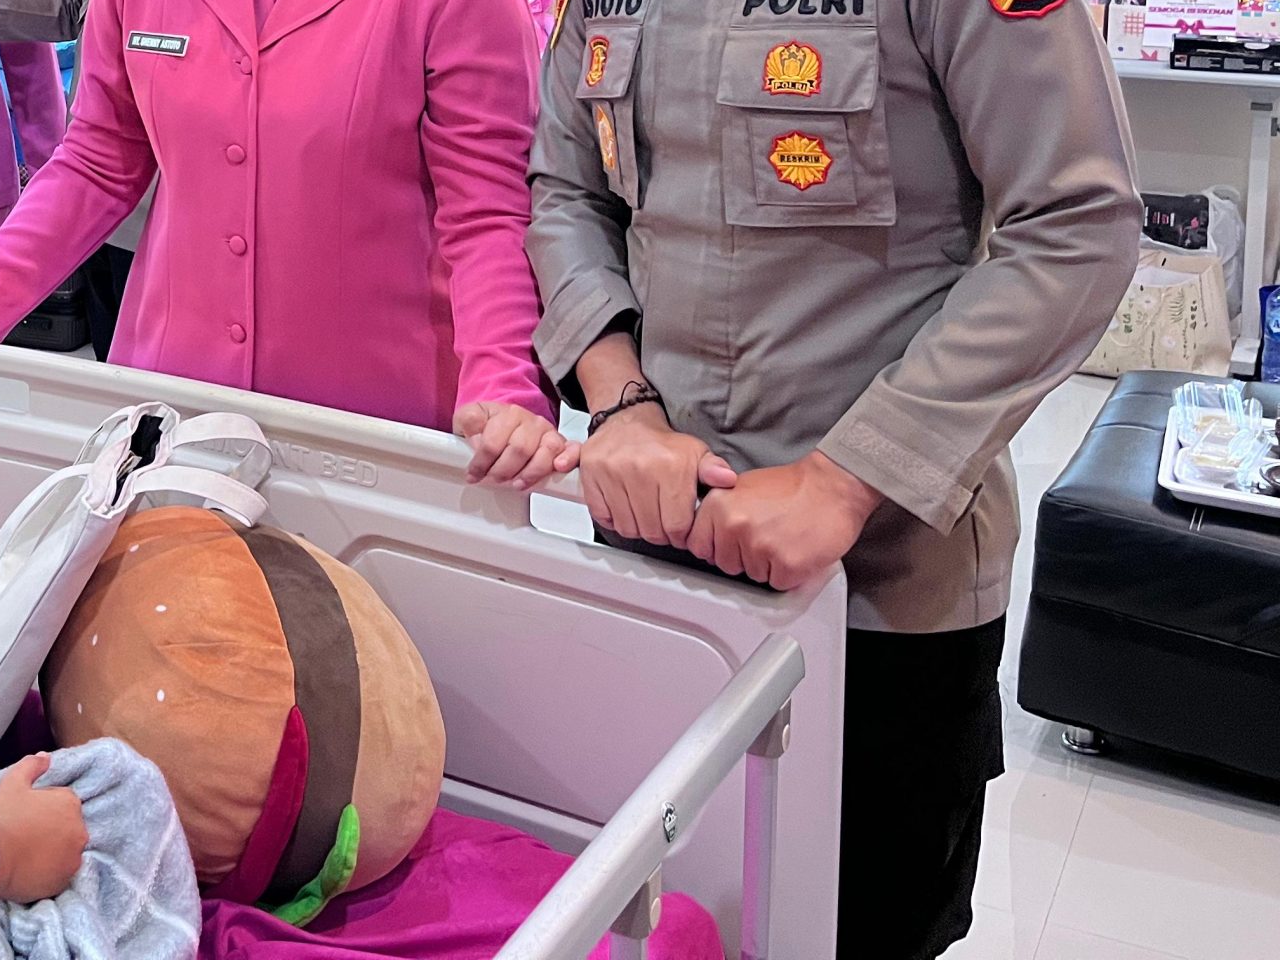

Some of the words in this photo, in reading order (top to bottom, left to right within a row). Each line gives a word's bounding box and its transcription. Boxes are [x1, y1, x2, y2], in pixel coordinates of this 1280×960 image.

[775, 81, 807, 91] POLRI
[780, 154, 821, 163] RESKRIM
[320, 450, 379, 488] BED
